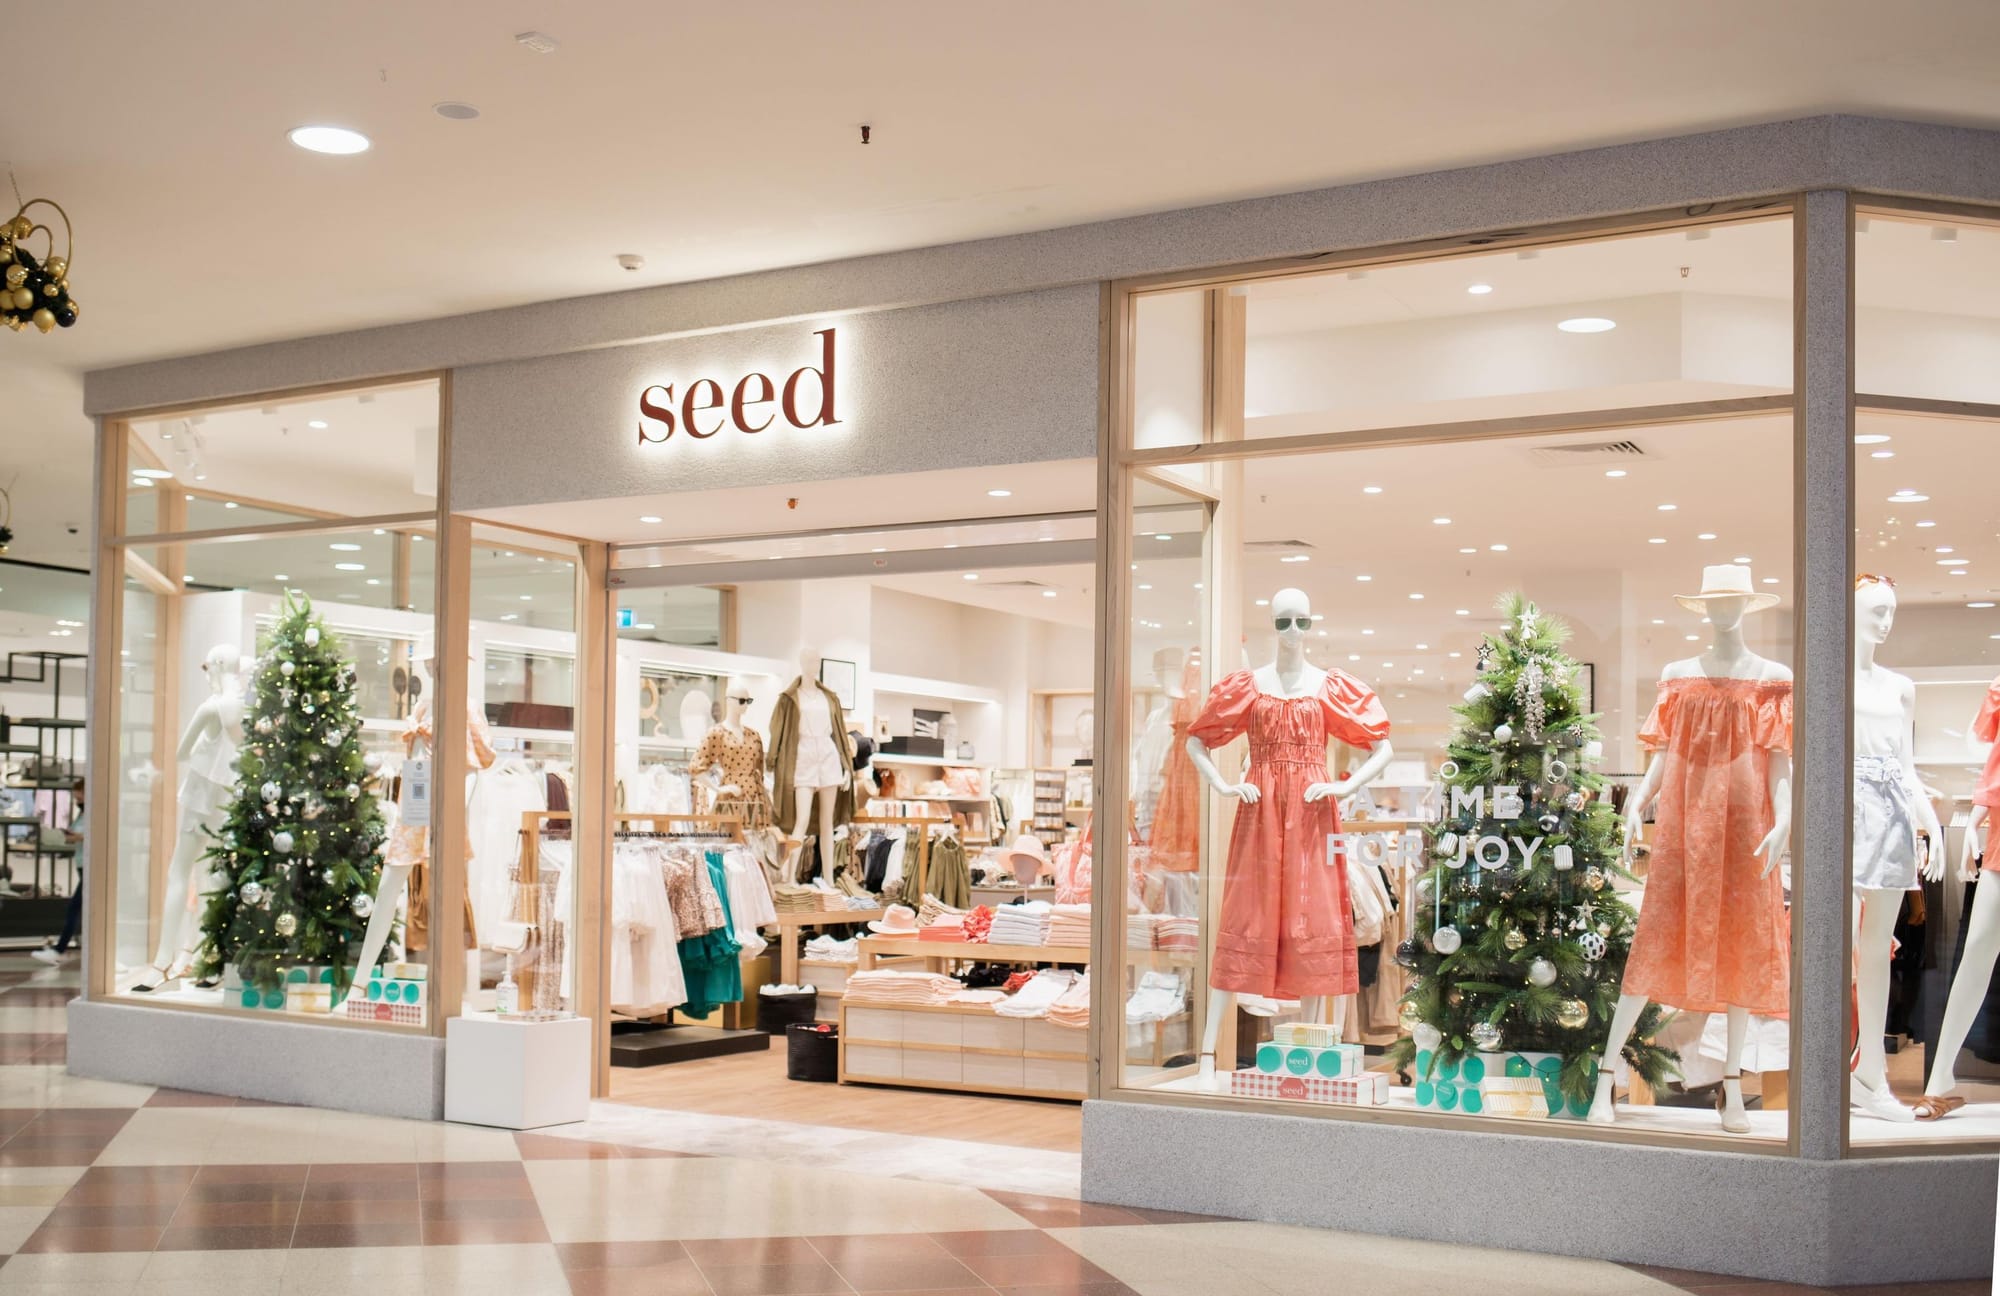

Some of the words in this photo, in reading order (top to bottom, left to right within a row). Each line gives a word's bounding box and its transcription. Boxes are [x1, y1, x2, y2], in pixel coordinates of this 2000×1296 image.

[638, 328, 843, 446] seed
[1349, 785, 1377, 818] A
[1400, 785, 1519, 819] TIME
[1326, 833, 1424, 868] FOR
[1444, 835, 1544, 870] JOY
[1288, 1056, 1308, 1066] seed
